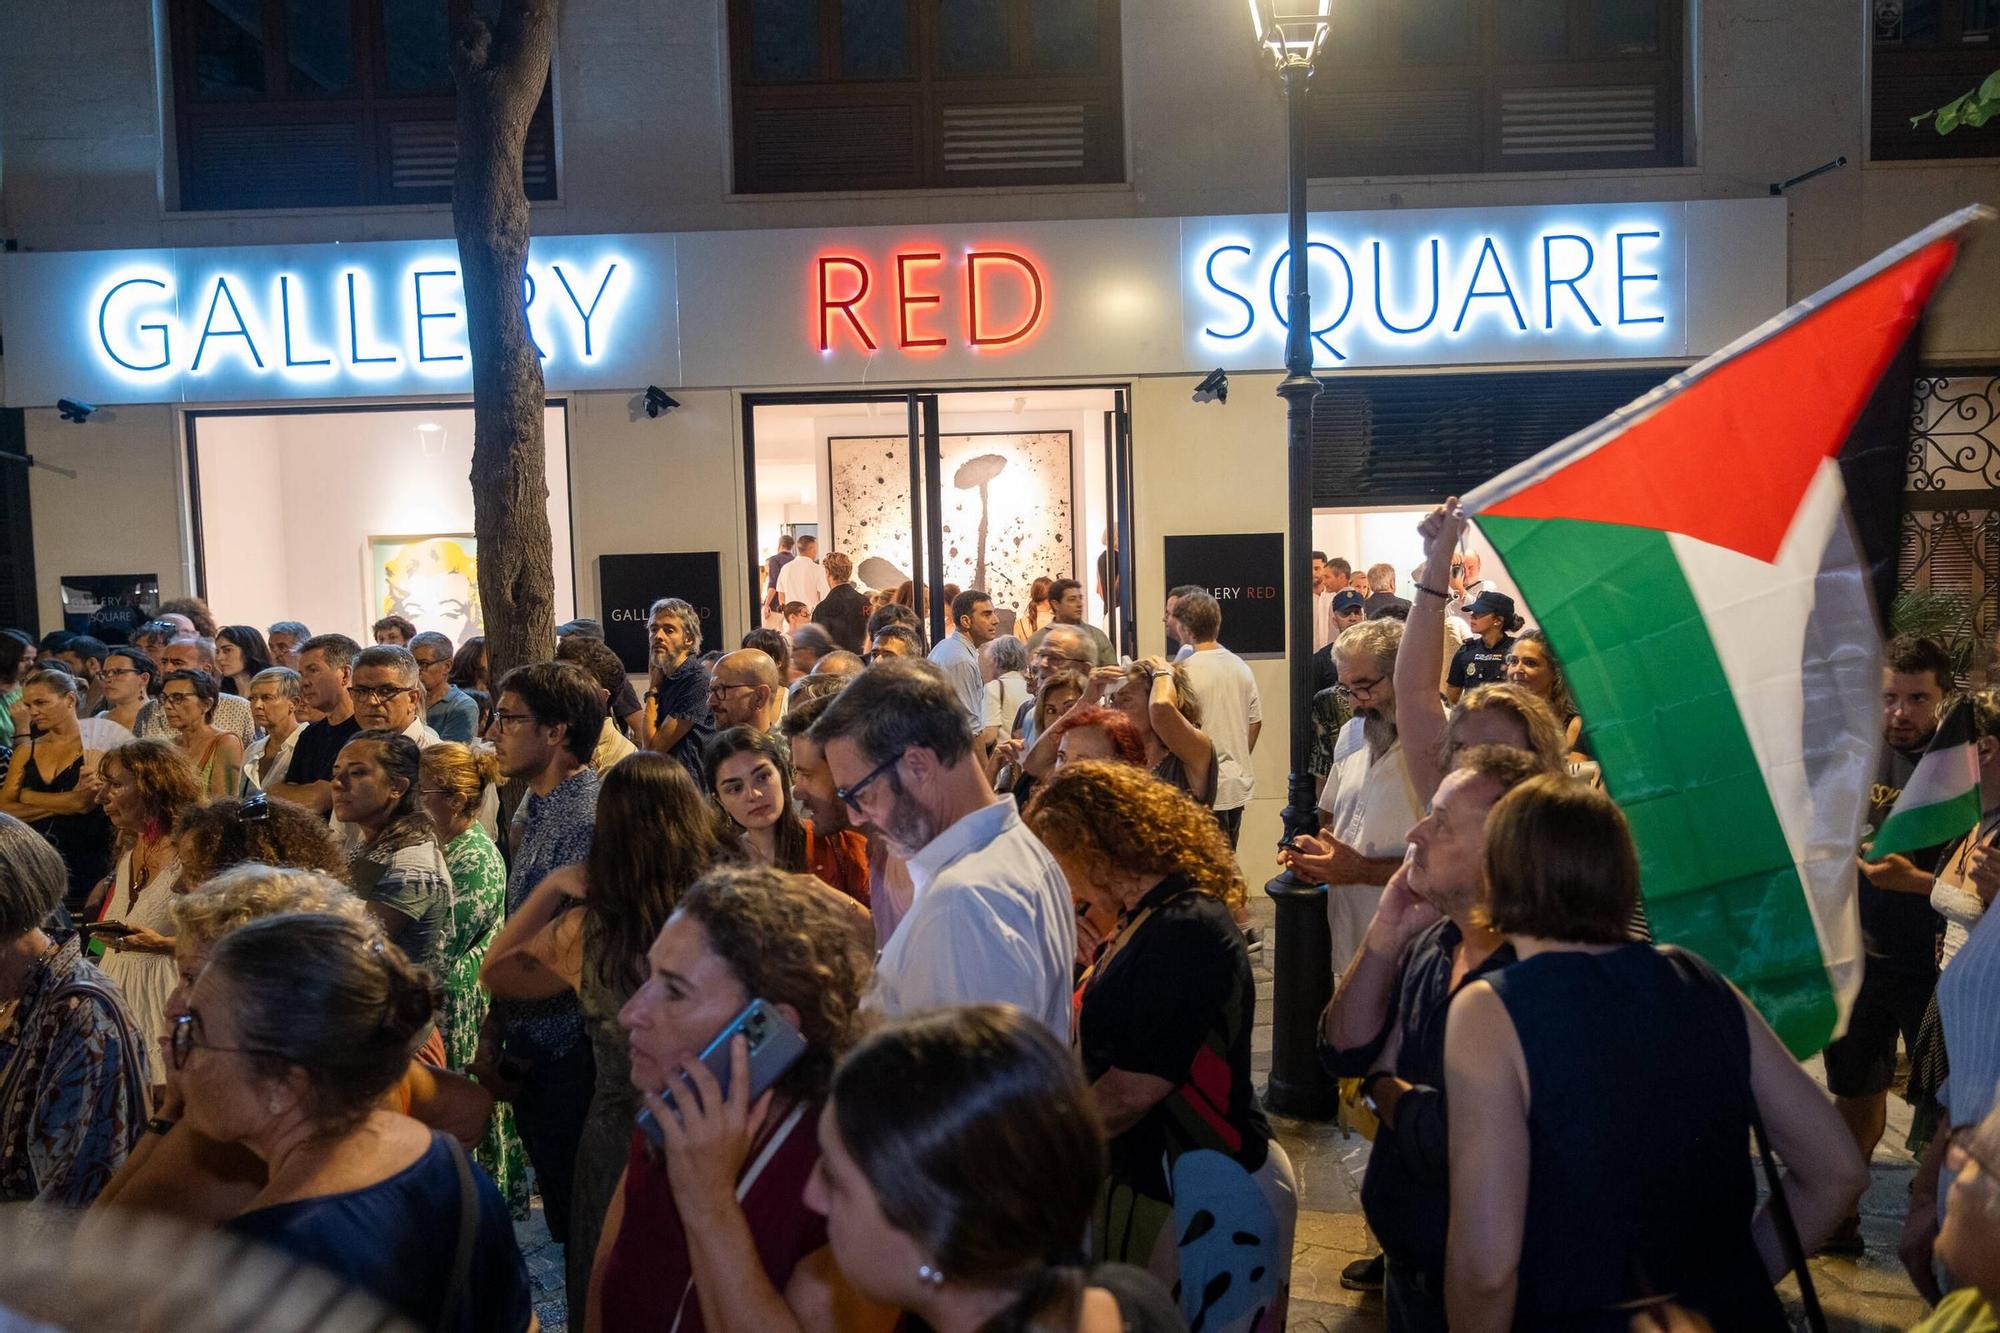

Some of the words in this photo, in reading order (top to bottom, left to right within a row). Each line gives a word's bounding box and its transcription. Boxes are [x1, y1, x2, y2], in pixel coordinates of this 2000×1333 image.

[818, 251, 1043, 351] RED
[1205, 231, 1665, 361] SQUARE
[1247, 586, 1276, 599] RED
[89, 611, 132, 624] SQUARE
[611, 608, 649, 621] GALL
